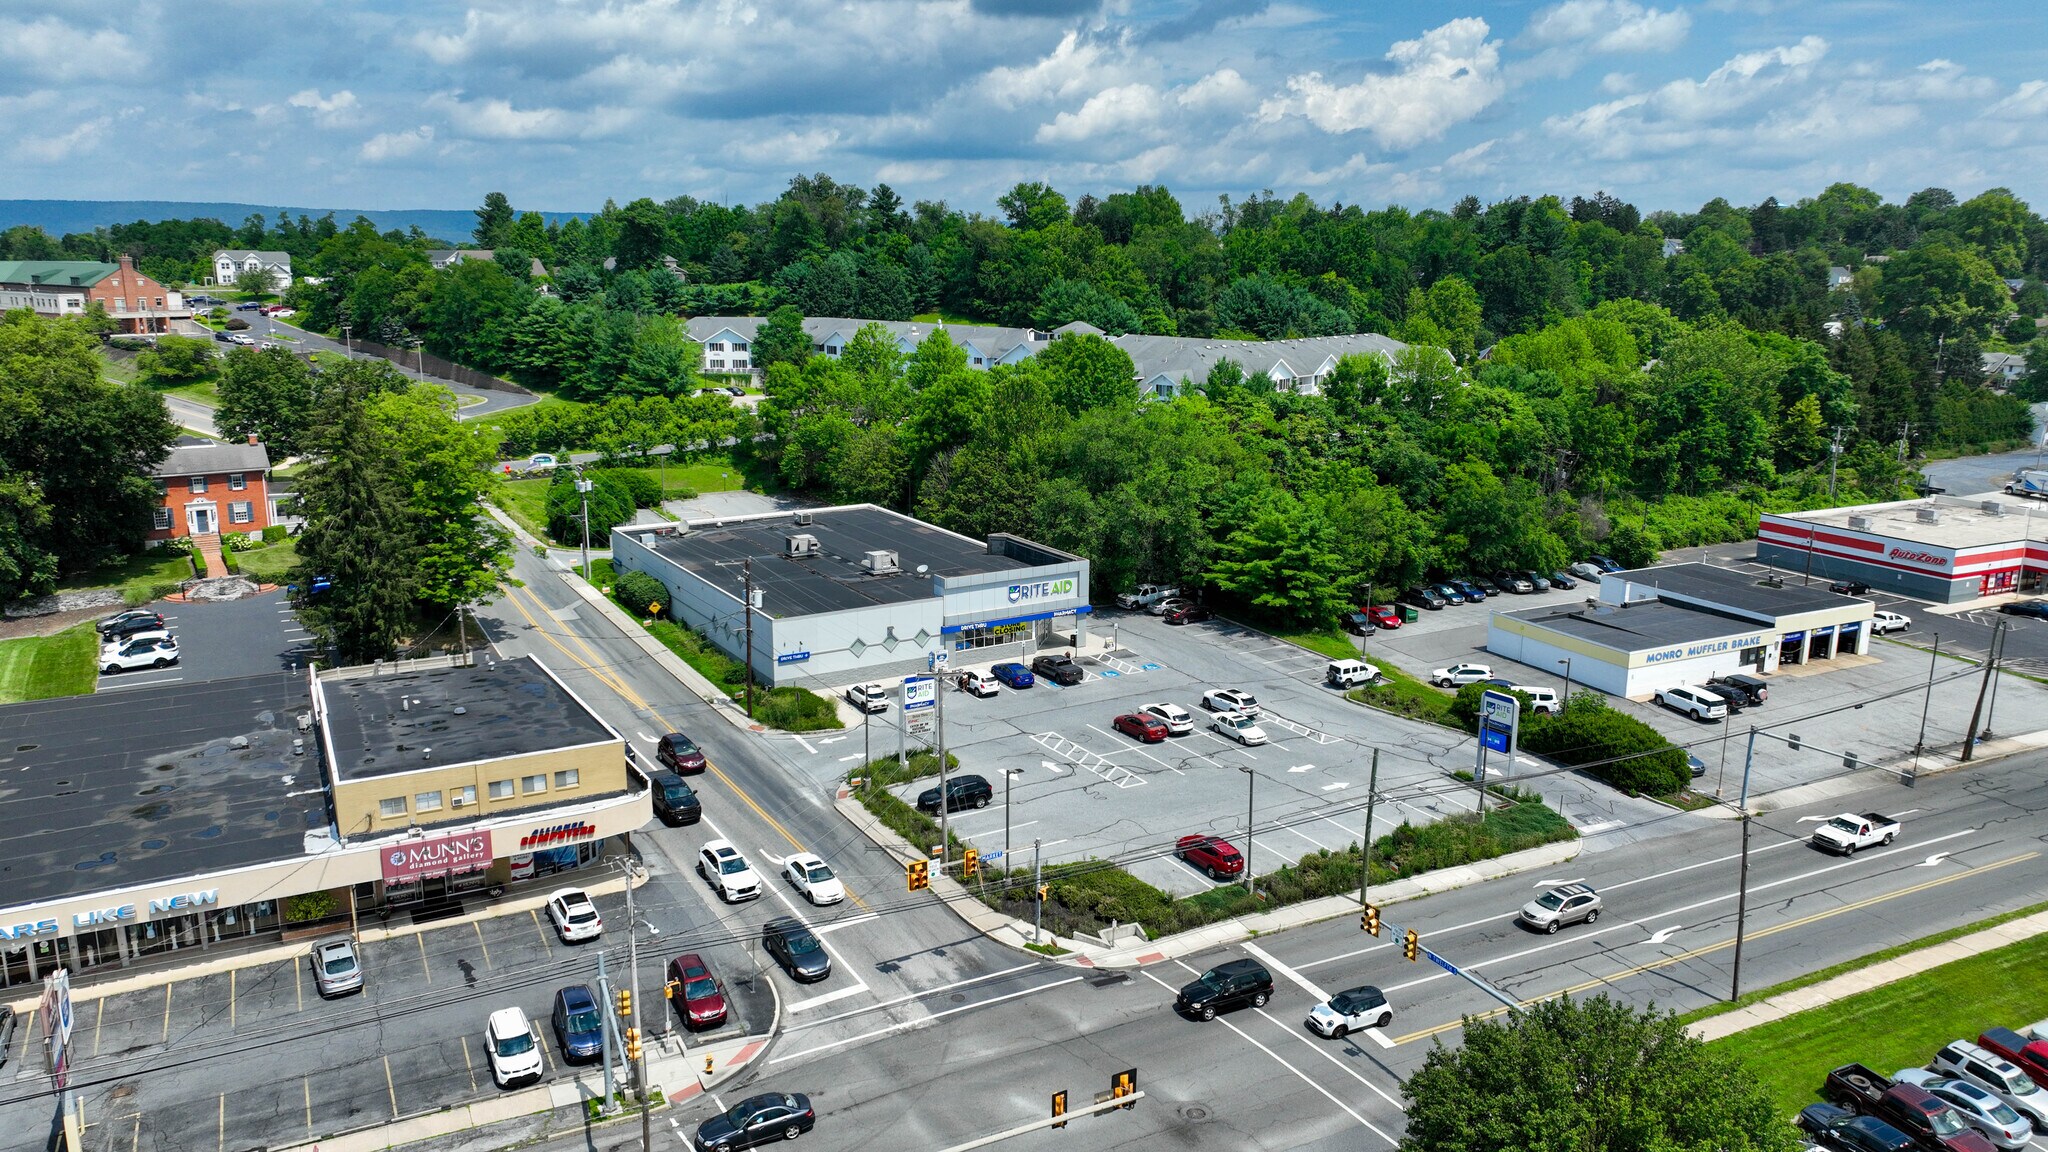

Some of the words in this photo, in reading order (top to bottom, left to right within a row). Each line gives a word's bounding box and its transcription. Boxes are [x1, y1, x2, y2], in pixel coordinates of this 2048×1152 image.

[1889, 547, 1947, 566] AutoZone
[1021, 582, 1050, 599] RITE
[1051, 580, 1072, 595] AID
[1053, 609, 1077, 617] PHARMACY
[960, 623, 974, 631] DRIVE
[994, 625, 1026, 636] CLOSING
[1646, 649, 1682, 663] MONRO
[1687, 641, 1728, 656] MUFFLER
[1731, 636, 1761, 649] BRAKE
[1497, 704, 1510, 713] RITE
[520, 825, 595, 846] COMPUTERS
[409, 836, 484, 863] MUNN'S
[409, 856, 448, 869] diamond
[453, 852, 484, 863] gallery
[73, 903, 135, 927] LIKE
[149, 888, 219, 914] NEW
